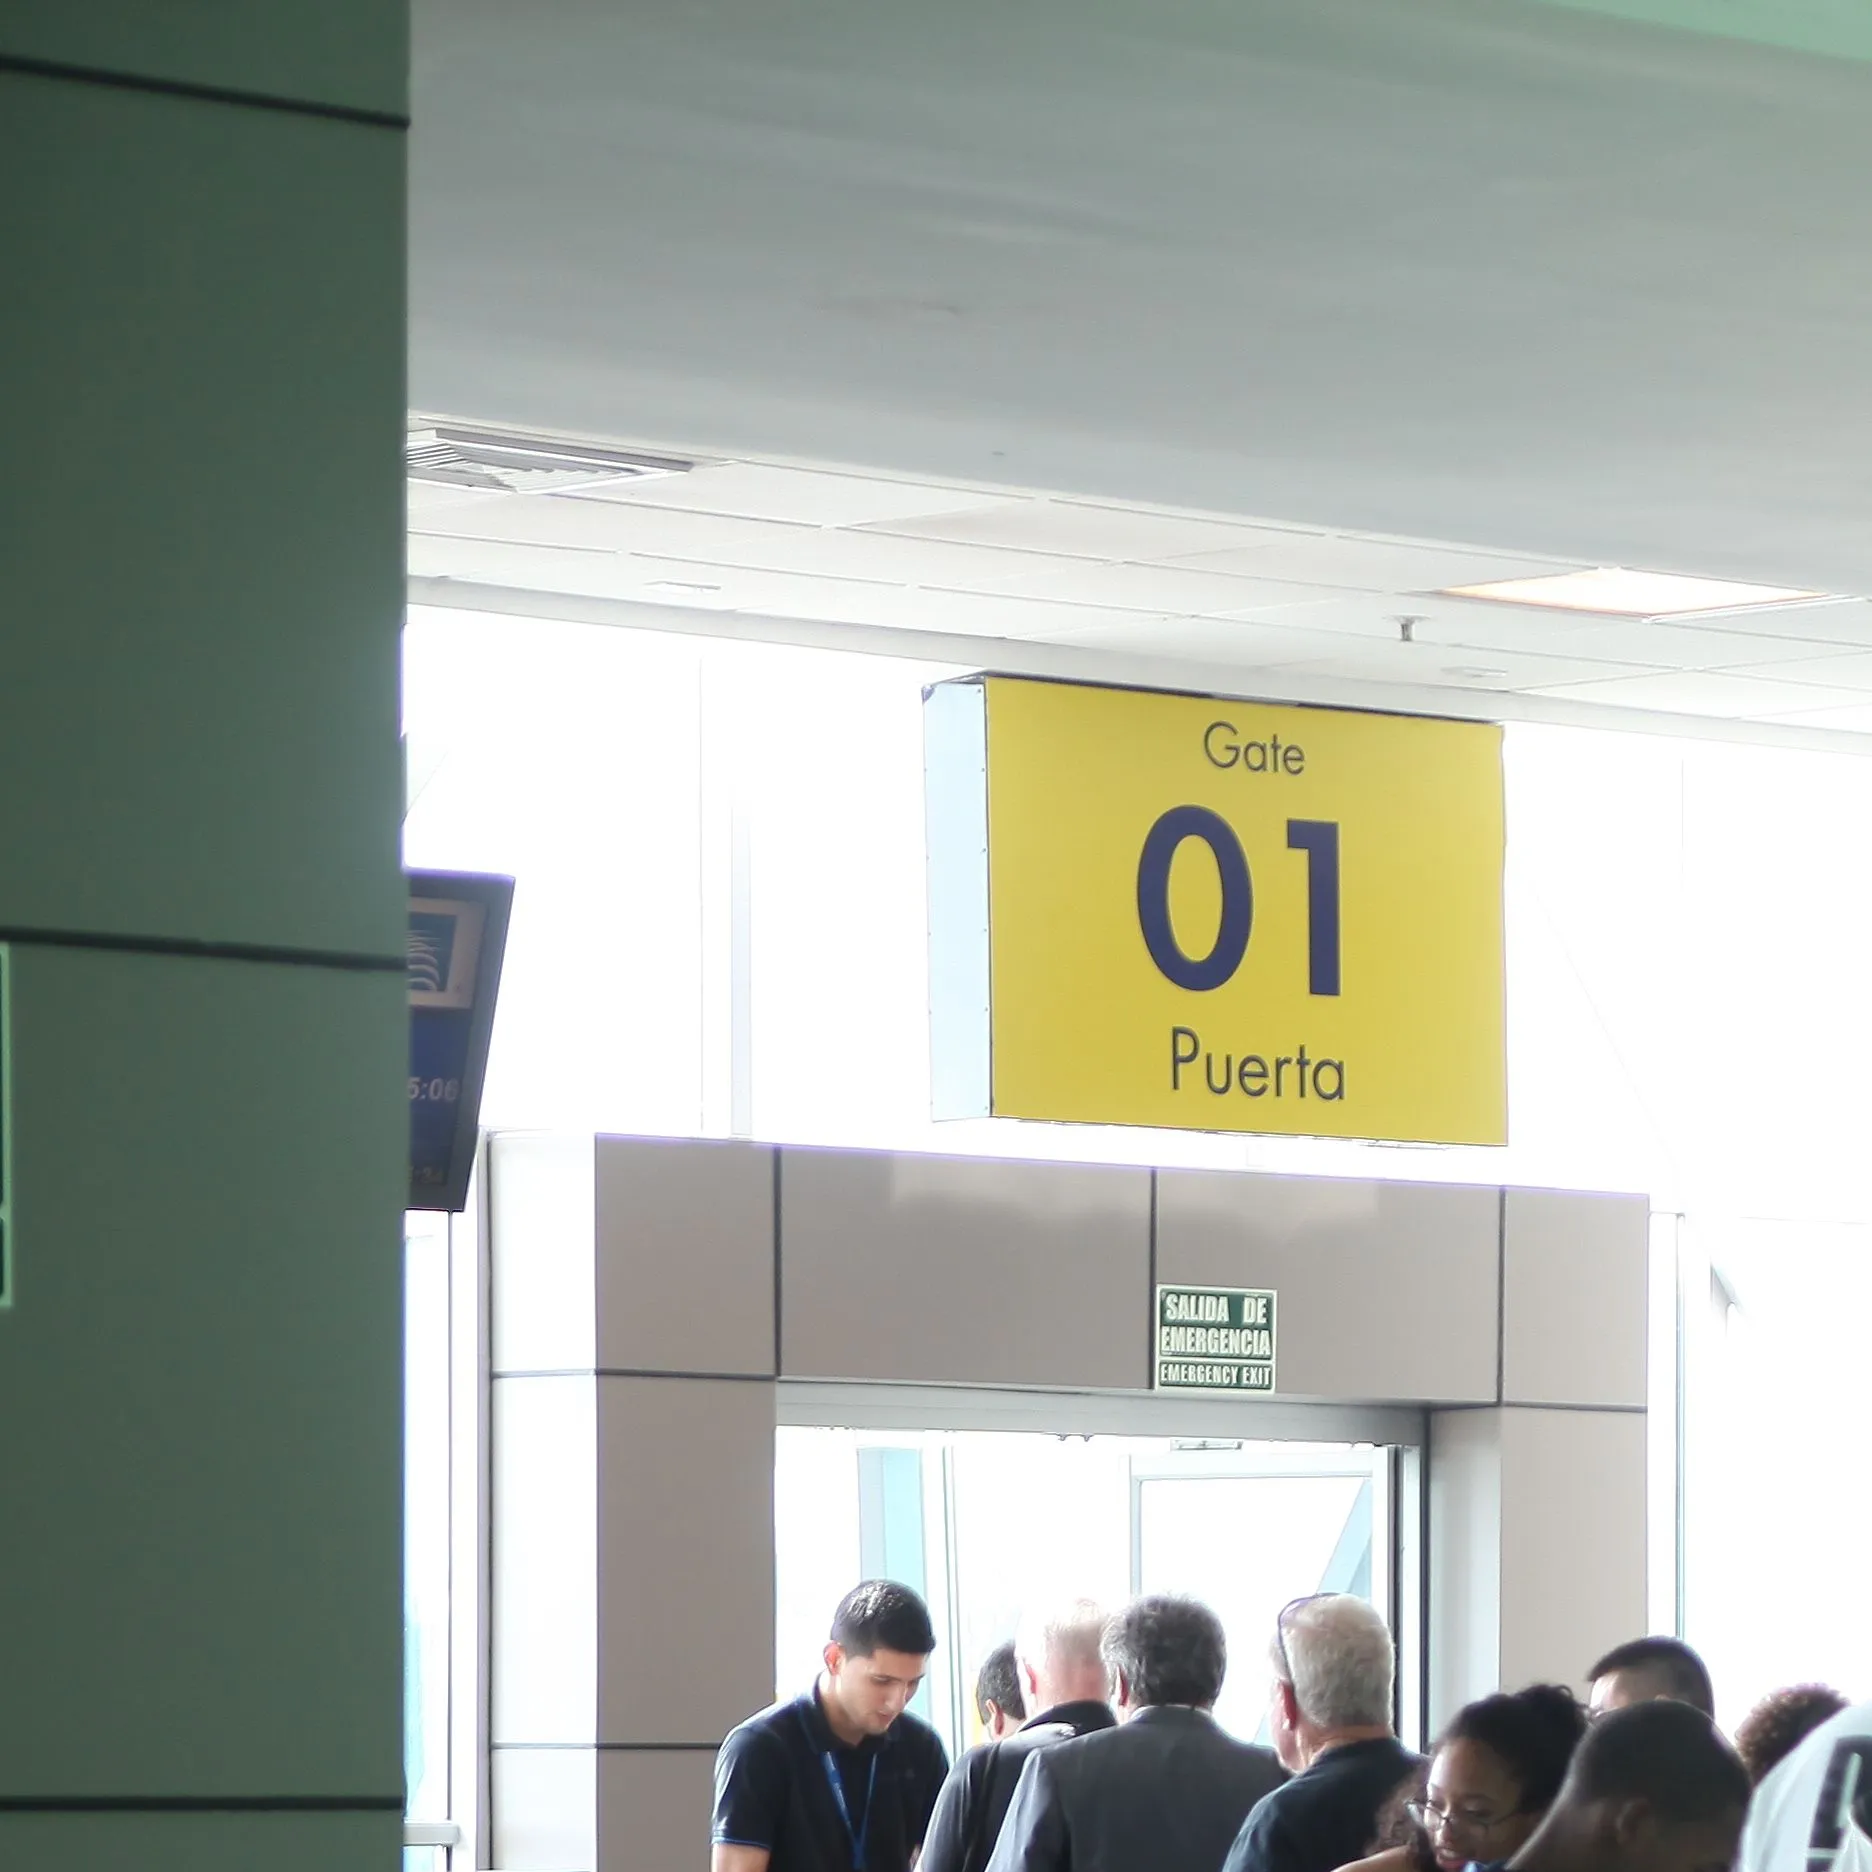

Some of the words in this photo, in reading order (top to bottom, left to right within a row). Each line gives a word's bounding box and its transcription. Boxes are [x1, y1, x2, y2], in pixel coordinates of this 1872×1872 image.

[1203, 720, 1306, 776] Gate
[1136, 803, 1341, 997] 01
[1171, 1025, 1345, 1101] Puerta
[1165, 1292, 1230, 1323] SALIDA
[1242, 1296, 1268, 1325] DE
[1160, 1325, 1271, 1356] EMERGENCIA
[1160, 1363, 1240, 1384] EMERGENCY
[1242, 1366, 1272, 1386] EXIT
